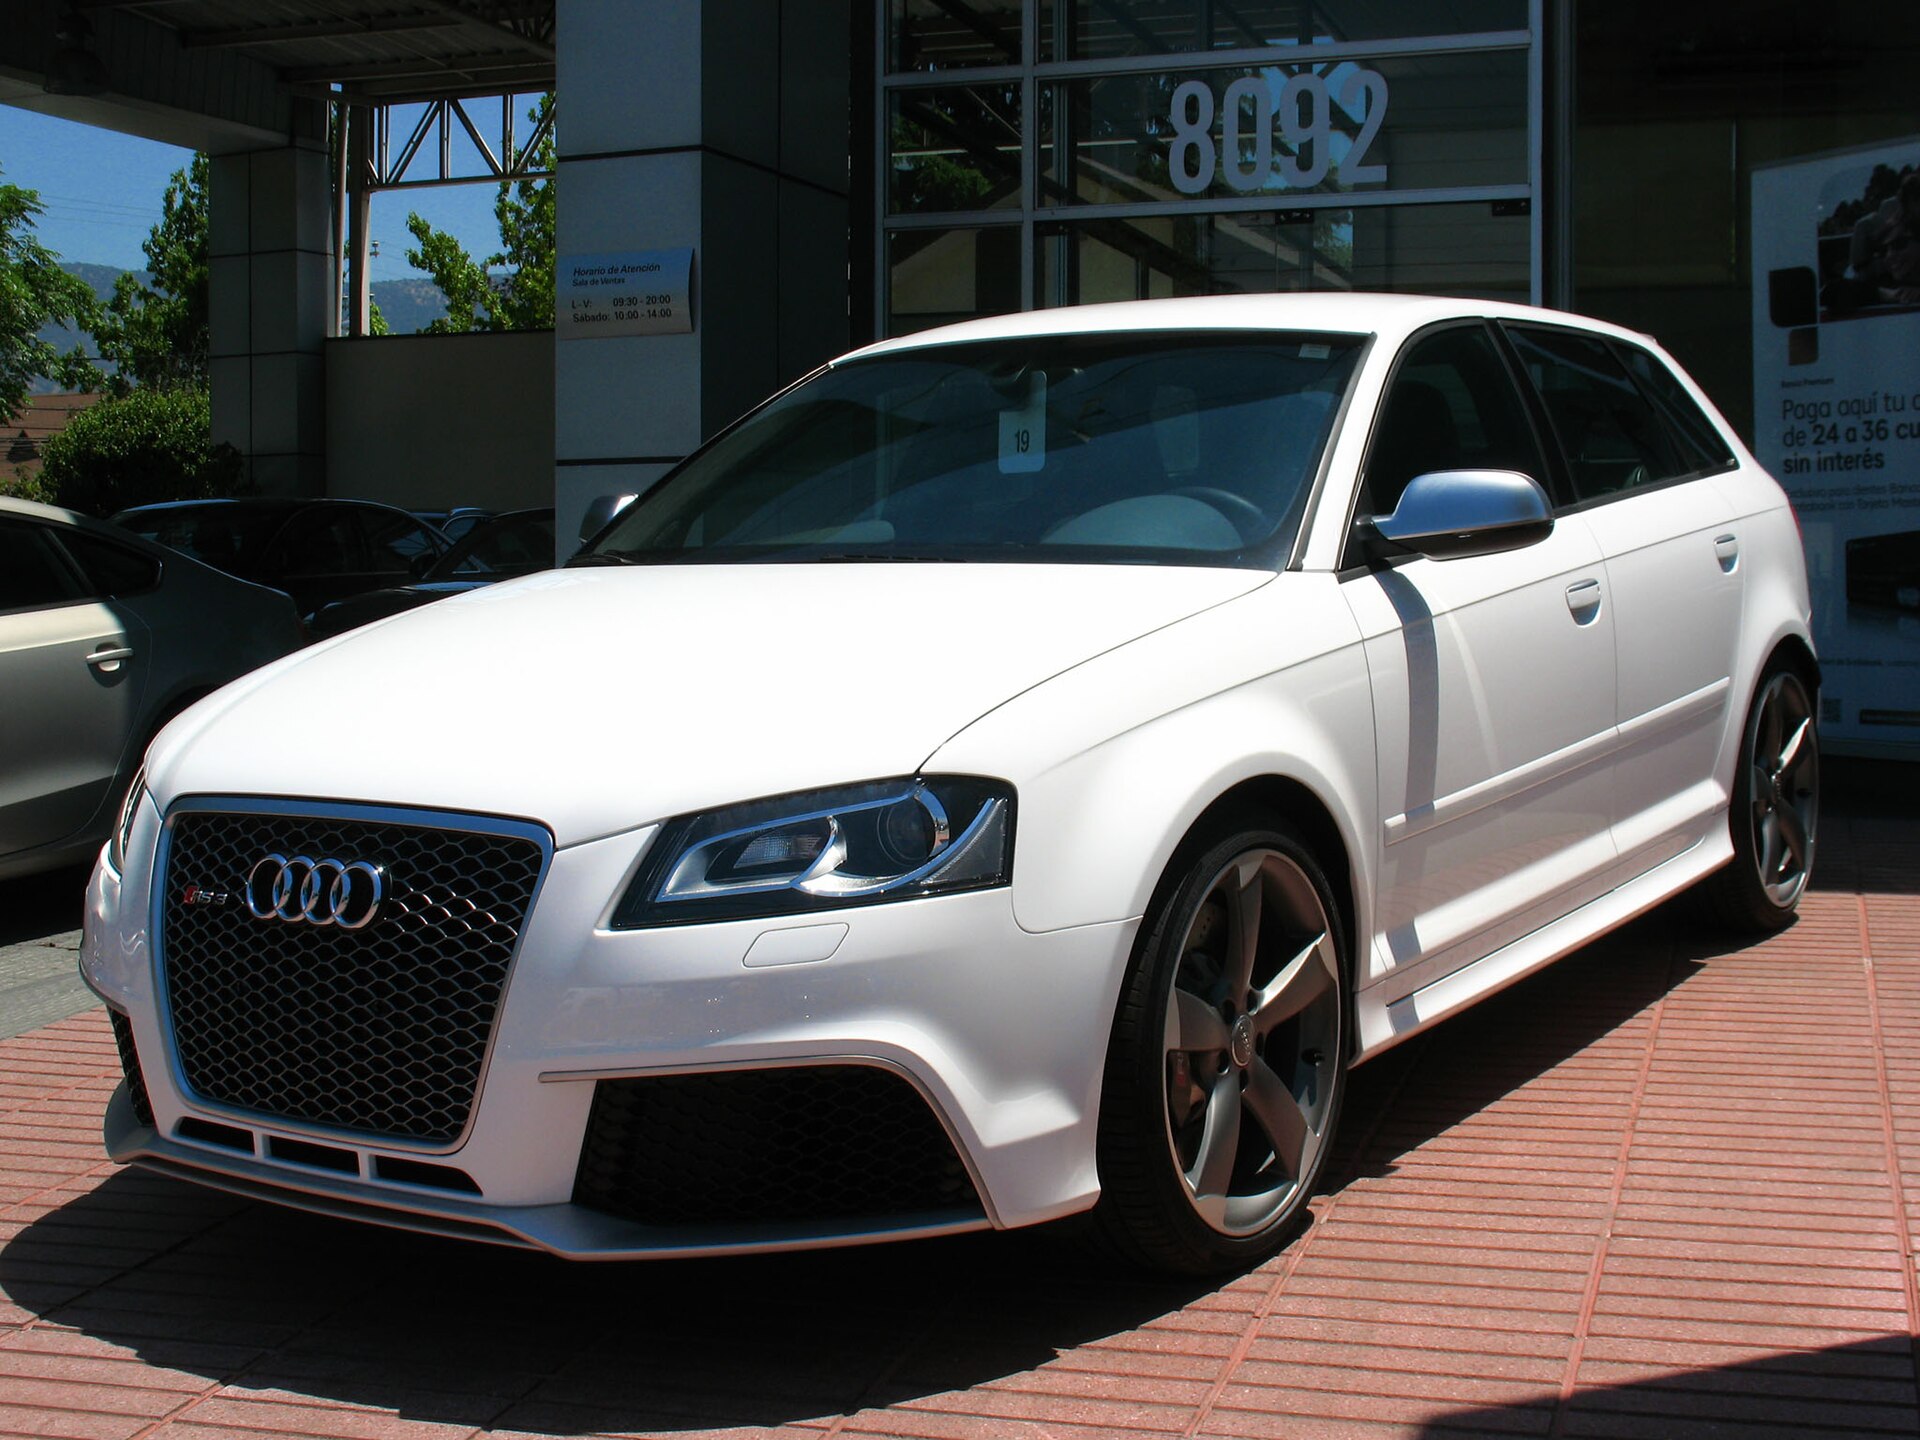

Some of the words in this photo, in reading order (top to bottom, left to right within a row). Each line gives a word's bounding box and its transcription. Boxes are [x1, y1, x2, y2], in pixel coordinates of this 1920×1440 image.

[1168, 69, 1389, 194] 8092
[573, 267, 606, 277] Horario
[607, 265, 620, 274] de
[620, 263, 660, 274] Atención
[572, 279, 589, 287] Sala
[590, 278, 600, 286] de
[613, 296, 638, 308] 09:30
[645, 294, 671, 306] 20:00
[614, 310, 639, 321] 10:00
[647, 308, 672, 319] 14:00
[1783, 399, 1830, 424] Paga
[1837, 391, 1878, 419] aquí
[1884, 393, 1905, 412] tu
[1015, 430, 1030, 453] 19
[1783, 425, 1807, 447] de
[1812, 422, 1838, 445] 24
[1845, 427, 1857, 442] a
[1863, 419, 1888, 441] 36
[1784, 452, 1811, 474] sin
[1817, 448, 1885, 472] interés
